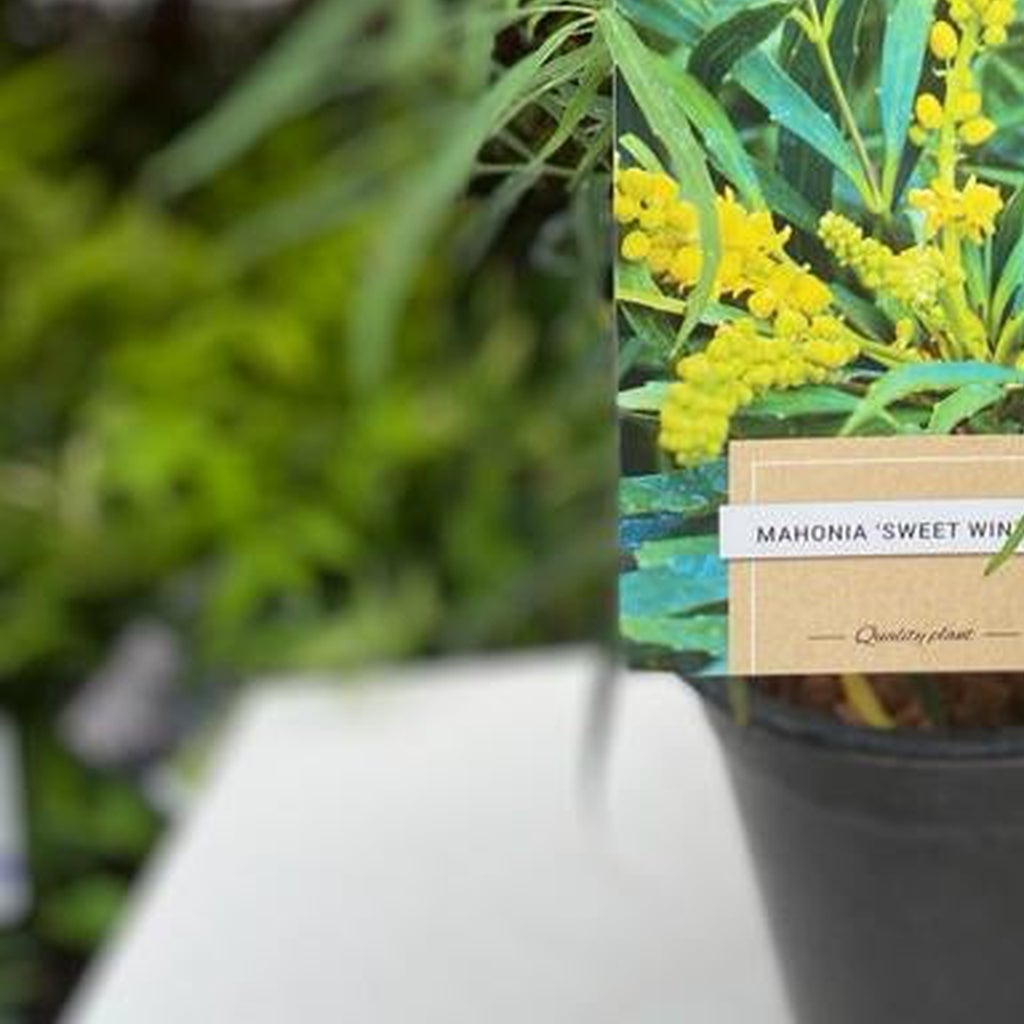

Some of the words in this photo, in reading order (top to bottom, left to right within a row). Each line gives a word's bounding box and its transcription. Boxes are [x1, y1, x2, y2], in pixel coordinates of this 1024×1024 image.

[756, 523, 868, 543] MAHONIA
[854, 624, 927, 647] Quality
[926, 626, 975, 645] plant
